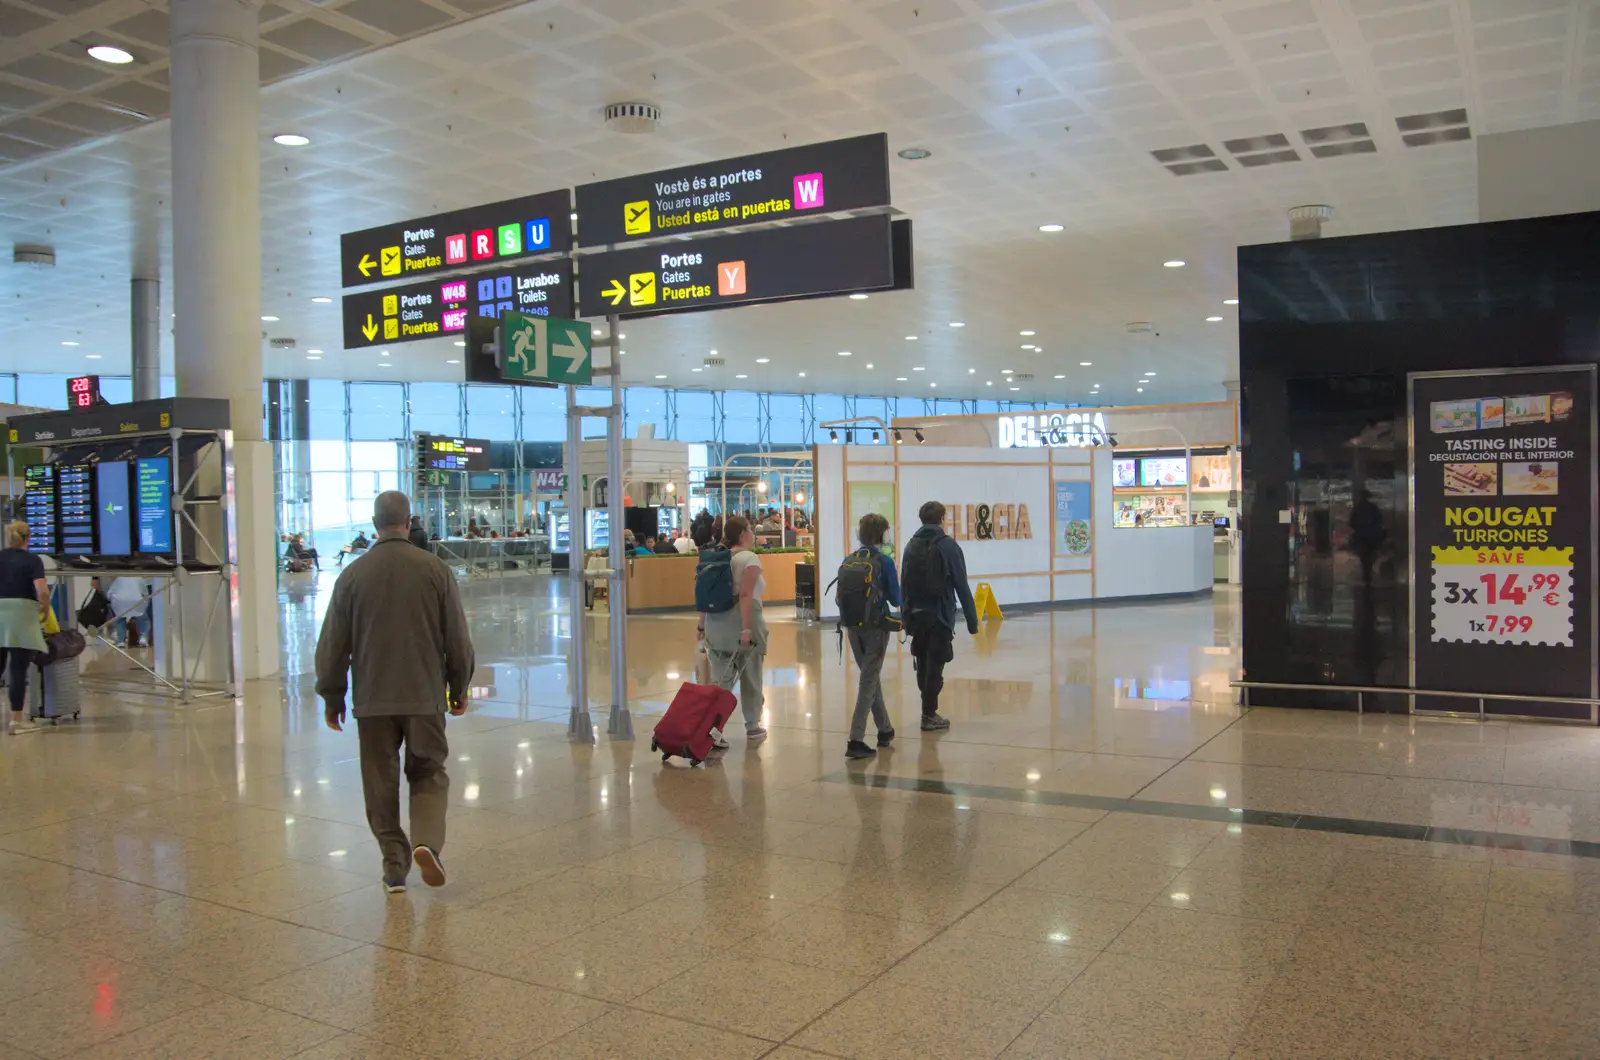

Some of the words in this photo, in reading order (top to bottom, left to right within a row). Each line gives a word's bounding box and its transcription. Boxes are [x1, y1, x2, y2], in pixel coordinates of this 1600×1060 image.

[655, 179, 690, 196] Vostè
[692, 177, 706, 190] és
[710, 178, 717, 187] a
[720, 168, 762, 189] portes
[798, 179, 818, 203] W
[656, 200, 674, 212] You
[675, 197, 690, 208] are
[692, 194, 700, 206] in
[702, 191, 730, 206] gates
[657, 211, 690, 228] Usted
[694, 208, 719, 223] está
[724, 208, 738, 219] en
[742, 199, 790, 219] puertas
[404, 229, 434, 243] Portes
[450, 239, 464, 259] M
[477, 235, 489, 254] R
[504, 230, 514, 249] S
[532, 224, 544, 244] U
[405, 244, 426, 256] Gates
[405, 256, 441, 270] Puertas
[661, 253, 702, 268] Portes
[517, 273, 560, 290] Lavabos
[662, 271, 690, 284] Gates
[724, 267, 740, 289] Y
[442, 284, 465, 300] W48
[517, 290, 547, 304] Toilets
[662, 284, 710, 300] Puertas
[401, 294, 432, 307] Portes
[402, 310, 423, 321] Gates
[402, 322, 438, 335] Puertas
[1445, 440, 1506, 451] TASTING
[1509, 437, 1557, 449] INSIDE
[1429, 451, 1497, 461] DEGUSTACIÓN
[1528, 451, 1574, 459] INTERIOR
[944, 503, 1032, 541] ELI&CIA
[1445, 507, 1557, 526] NOUGAT
[1453, 529, 1548, 543] TURRONES
[1477, 552, 1524, 563] SAVE
